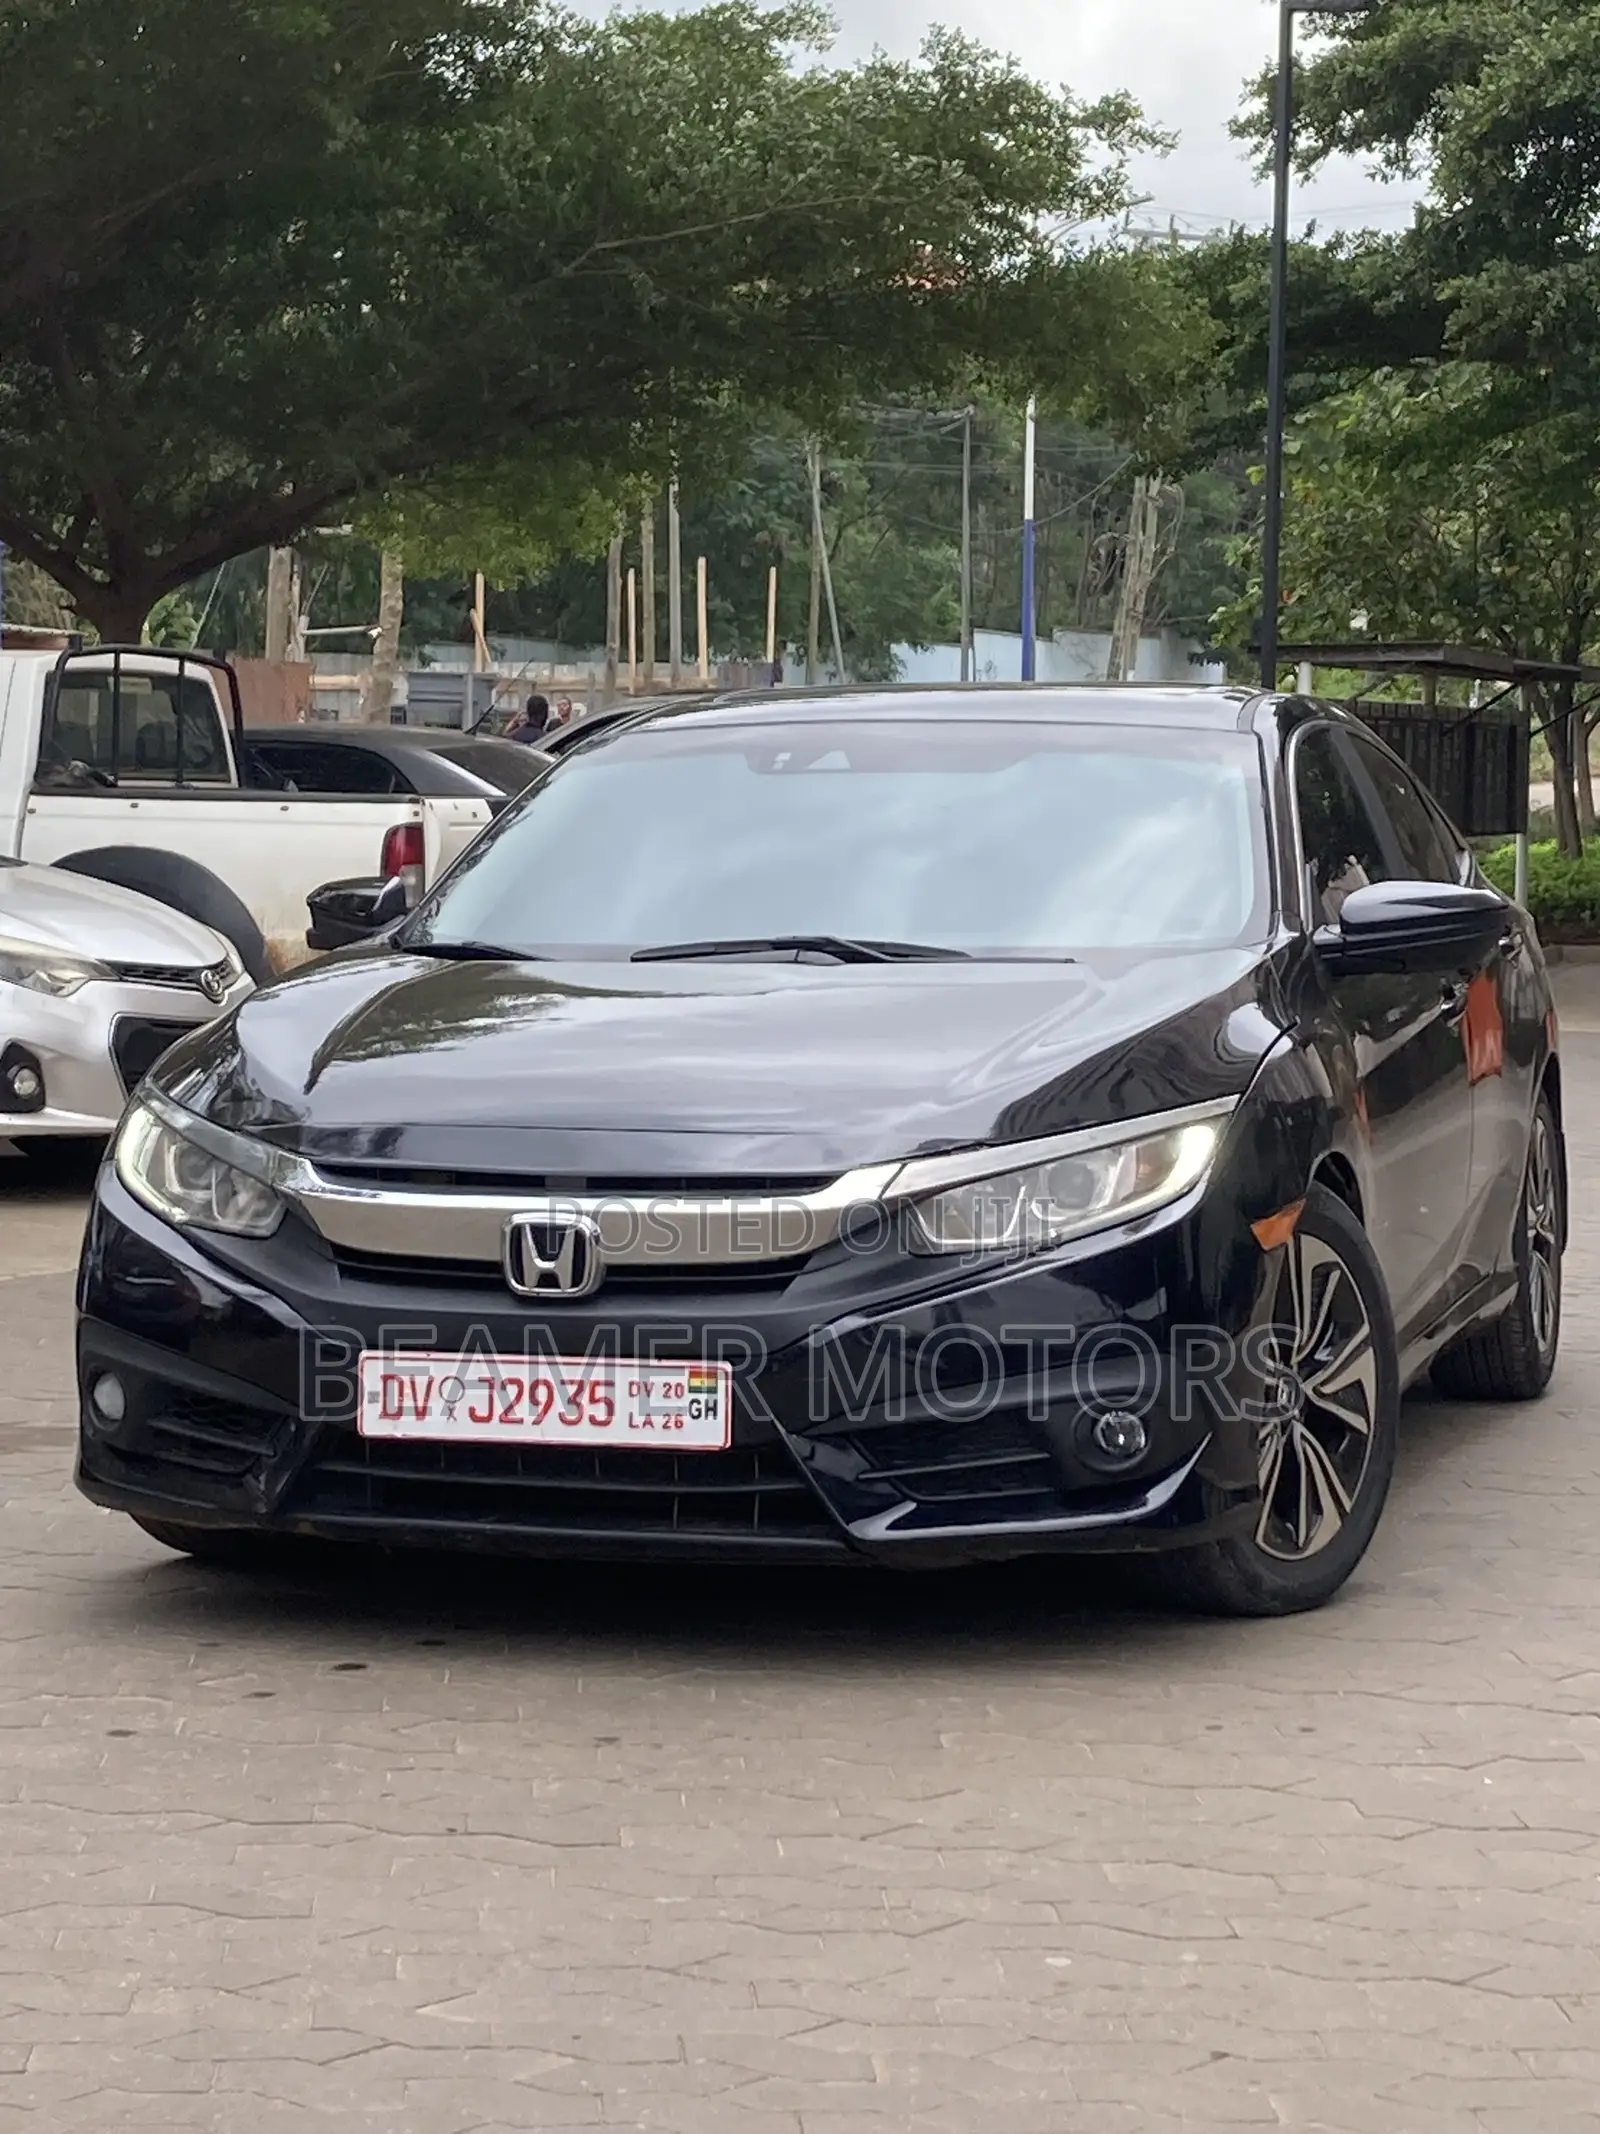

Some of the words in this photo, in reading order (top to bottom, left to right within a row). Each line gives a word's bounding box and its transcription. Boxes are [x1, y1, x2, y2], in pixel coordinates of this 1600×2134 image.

[628, 1380, 655, 1398] DV
[662, 1382, 685, 1399] 20
[379, 1374, 435, 1421] DV
[468, 1376, 616, 1427] J2935
[688, 1398, 718, 1420] GH
[628, 1411, 655, 1429] LA
[662, 1413, 684, 1430] 26
